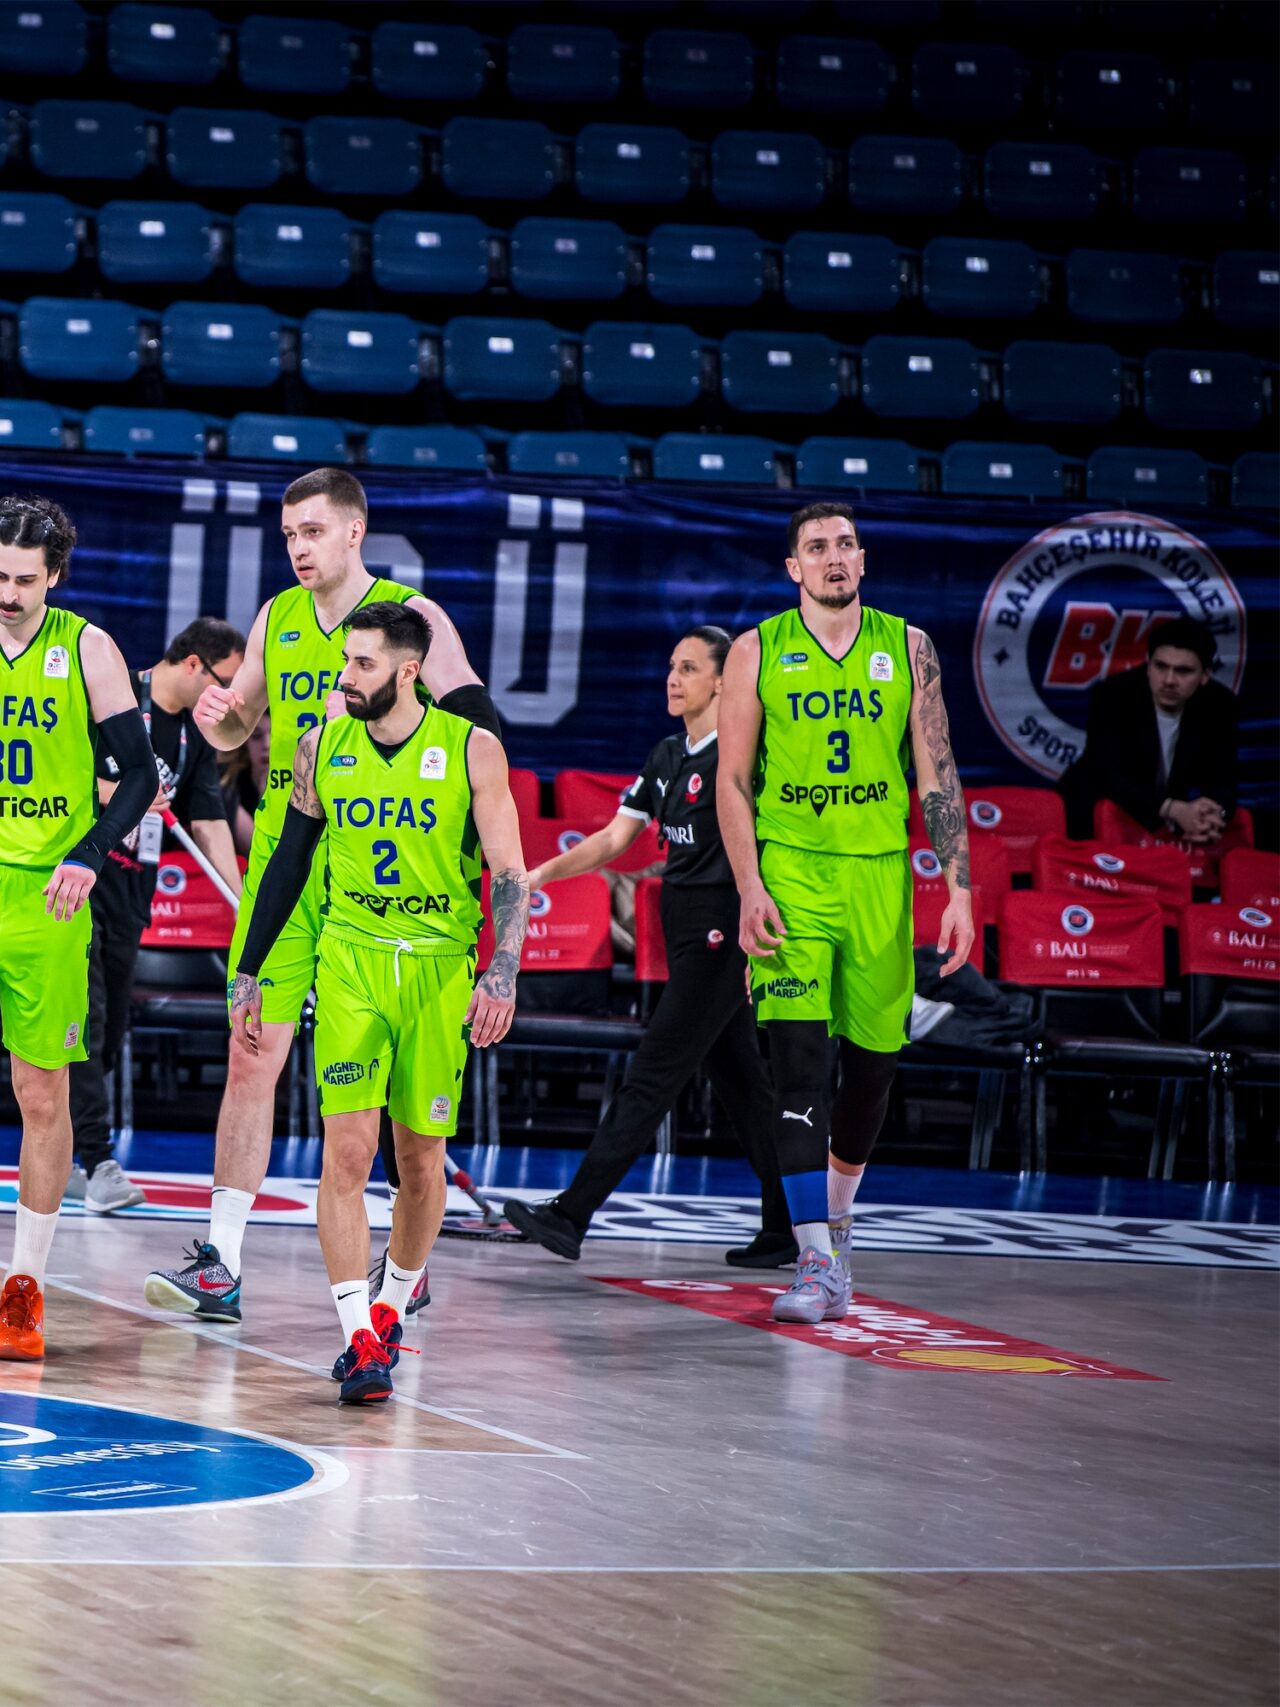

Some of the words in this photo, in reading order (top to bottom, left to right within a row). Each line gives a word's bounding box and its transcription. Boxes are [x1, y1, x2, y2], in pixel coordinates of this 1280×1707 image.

[996, 525, 1163, 633] BAHÇEŞEHİR
[786, 688, 884, 722] TOFAŞ
[826, 729, 850, 774] 3
[333, 797, 437, 834] TOFAŞ
[371, 840, 401, 885] 2
[1050, 941, 1088, 959] BAU
[1228, 930, 1267, 950] BAU
